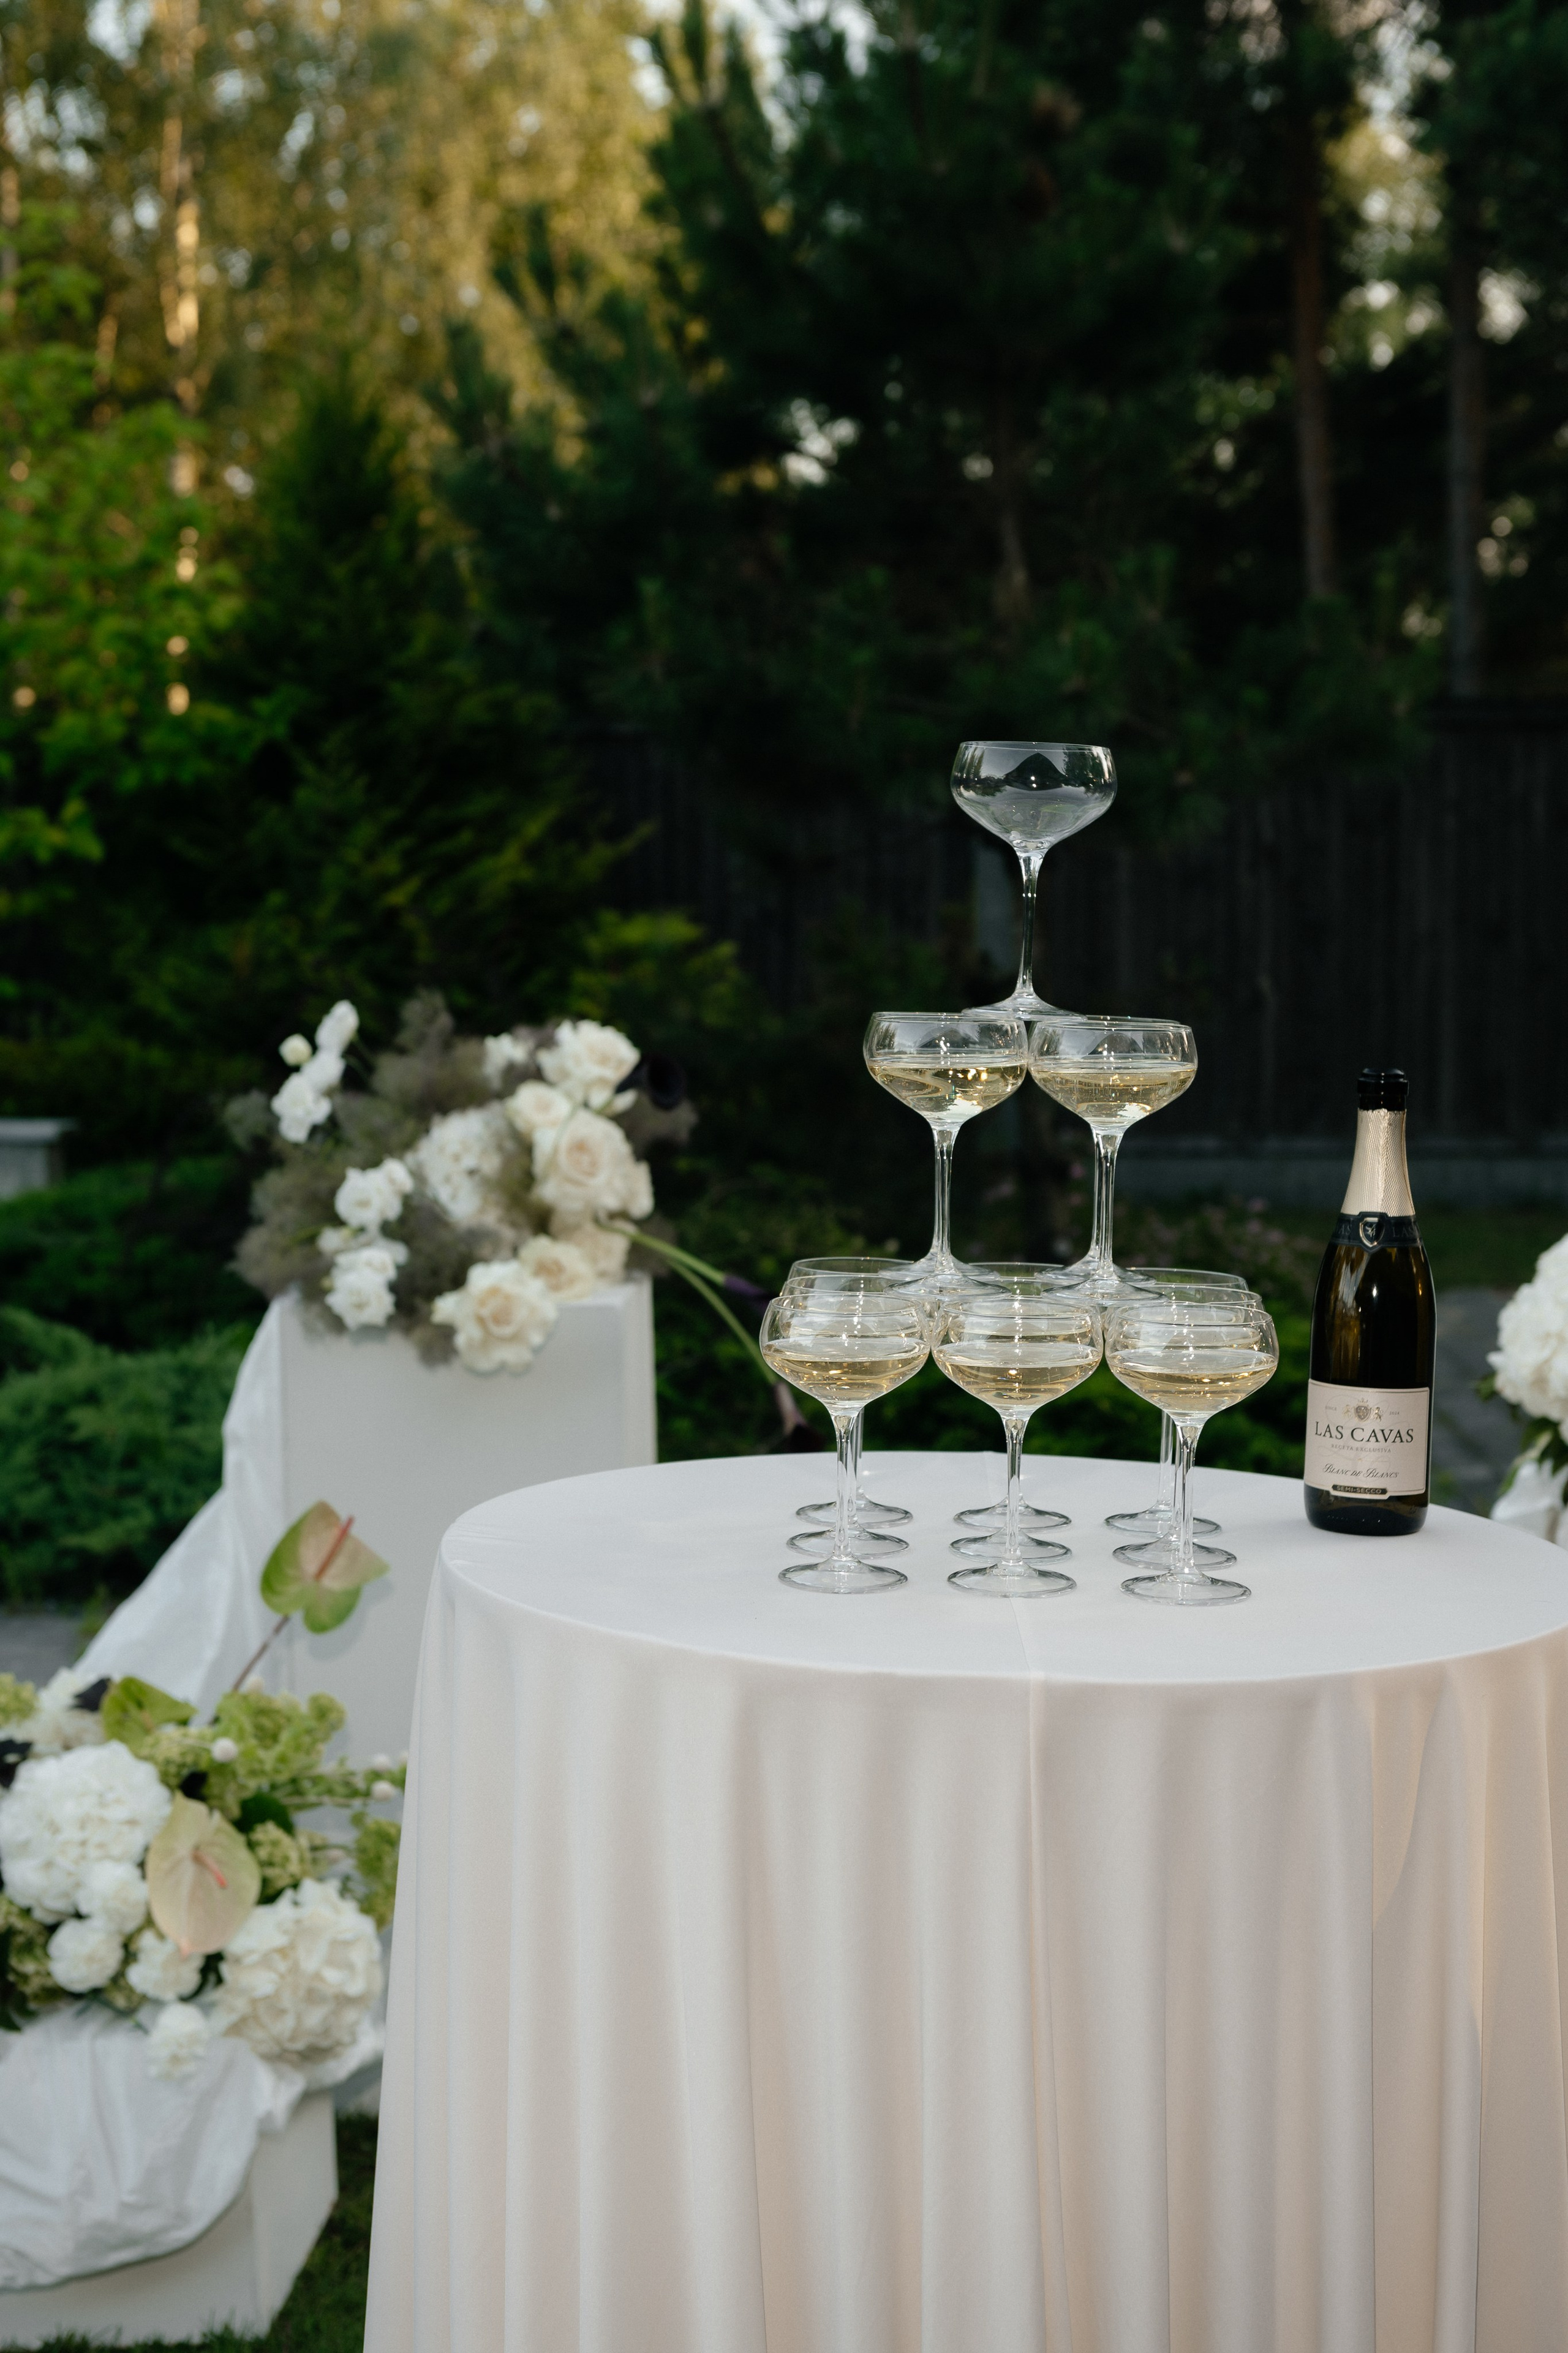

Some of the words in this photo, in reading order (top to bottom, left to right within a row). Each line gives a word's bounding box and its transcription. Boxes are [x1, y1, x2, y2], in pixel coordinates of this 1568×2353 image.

[1315, 1421, 1343, 1440] LAS
[1351, 1427, 1414, 1443] CAVAS
[1336, 1485, 1382, 1494] SEMI-SECCO
